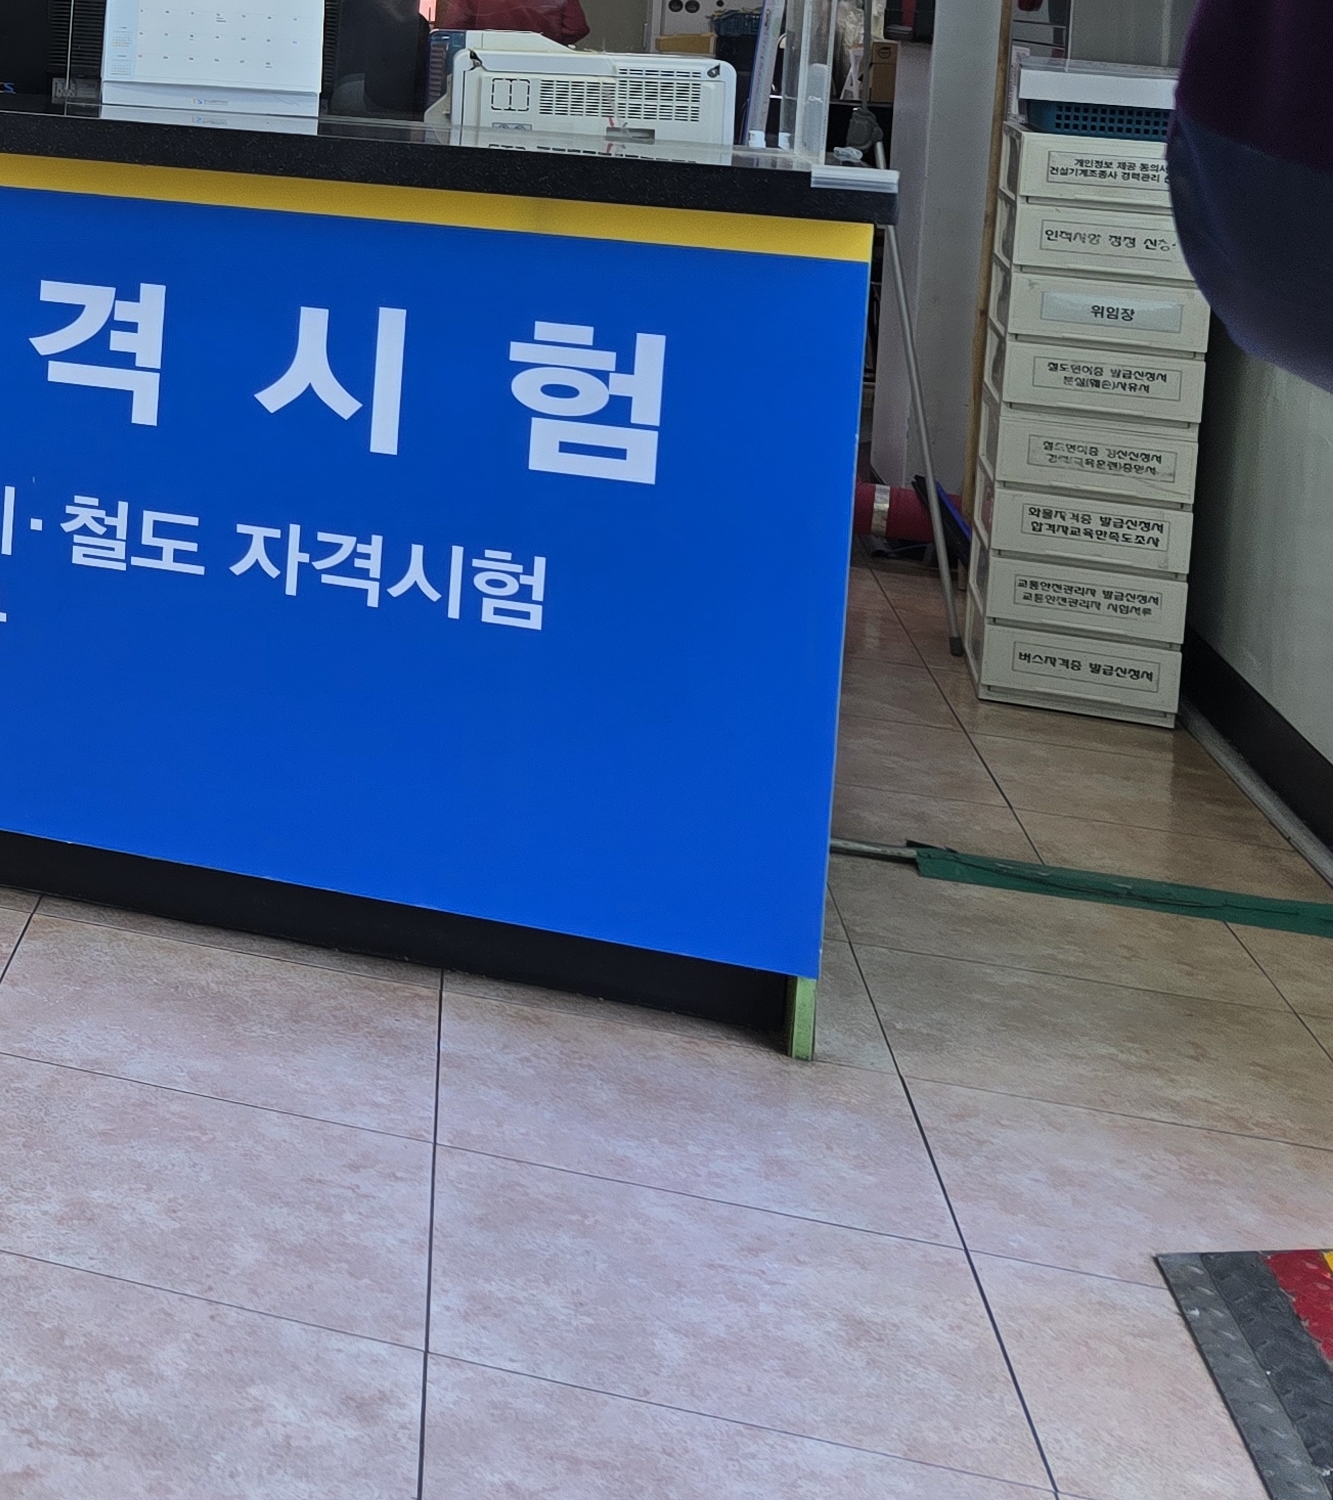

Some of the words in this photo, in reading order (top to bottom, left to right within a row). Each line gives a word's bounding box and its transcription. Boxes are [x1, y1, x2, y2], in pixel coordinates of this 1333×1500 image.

[1074, 158, 1114, 170] 개인정보
[1116, 161, 1136, 172] 제공
[1090, 304, 1135, 322] 위임장
[228, 515, 550, 631] 자격시험
[1018, 651, 1083, 672] 버스자격증
